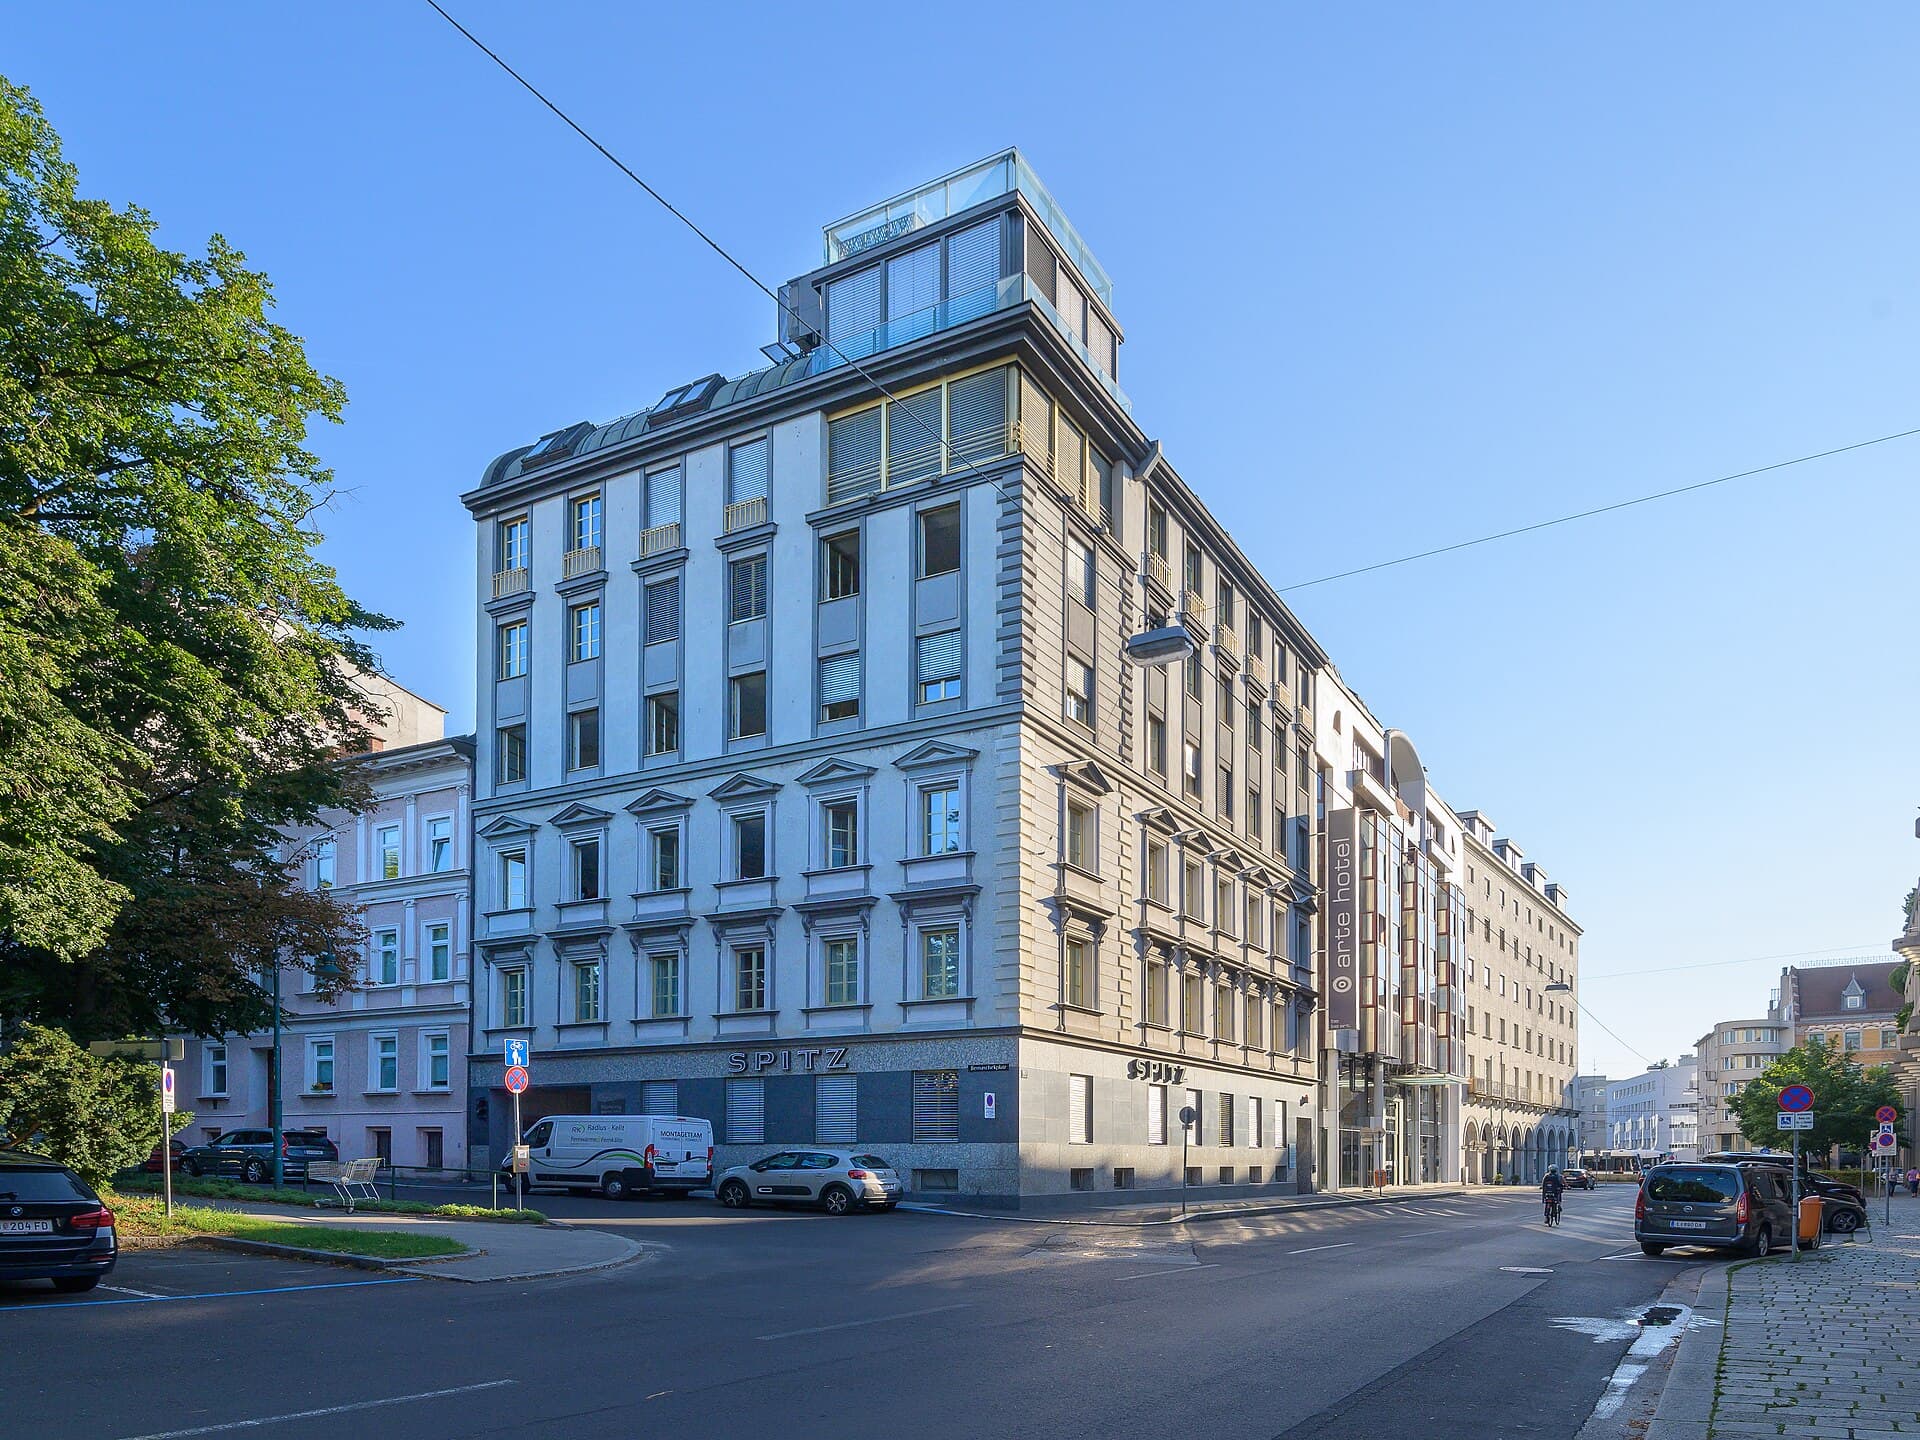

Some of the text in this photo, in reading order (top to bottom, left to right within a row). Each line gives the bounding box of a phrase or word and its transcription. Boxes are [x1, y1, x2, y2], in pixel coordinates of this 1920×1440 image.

[1332, 837, 1351, 969] arte hotel
[728, 1047, 850, 1073] SPITZ
[1127, 1059, 1188, 1085] SPITZ
[660, 1131, 703, 1139] MONTAGETEAM
[10, 1222, 31, 1231] 204
